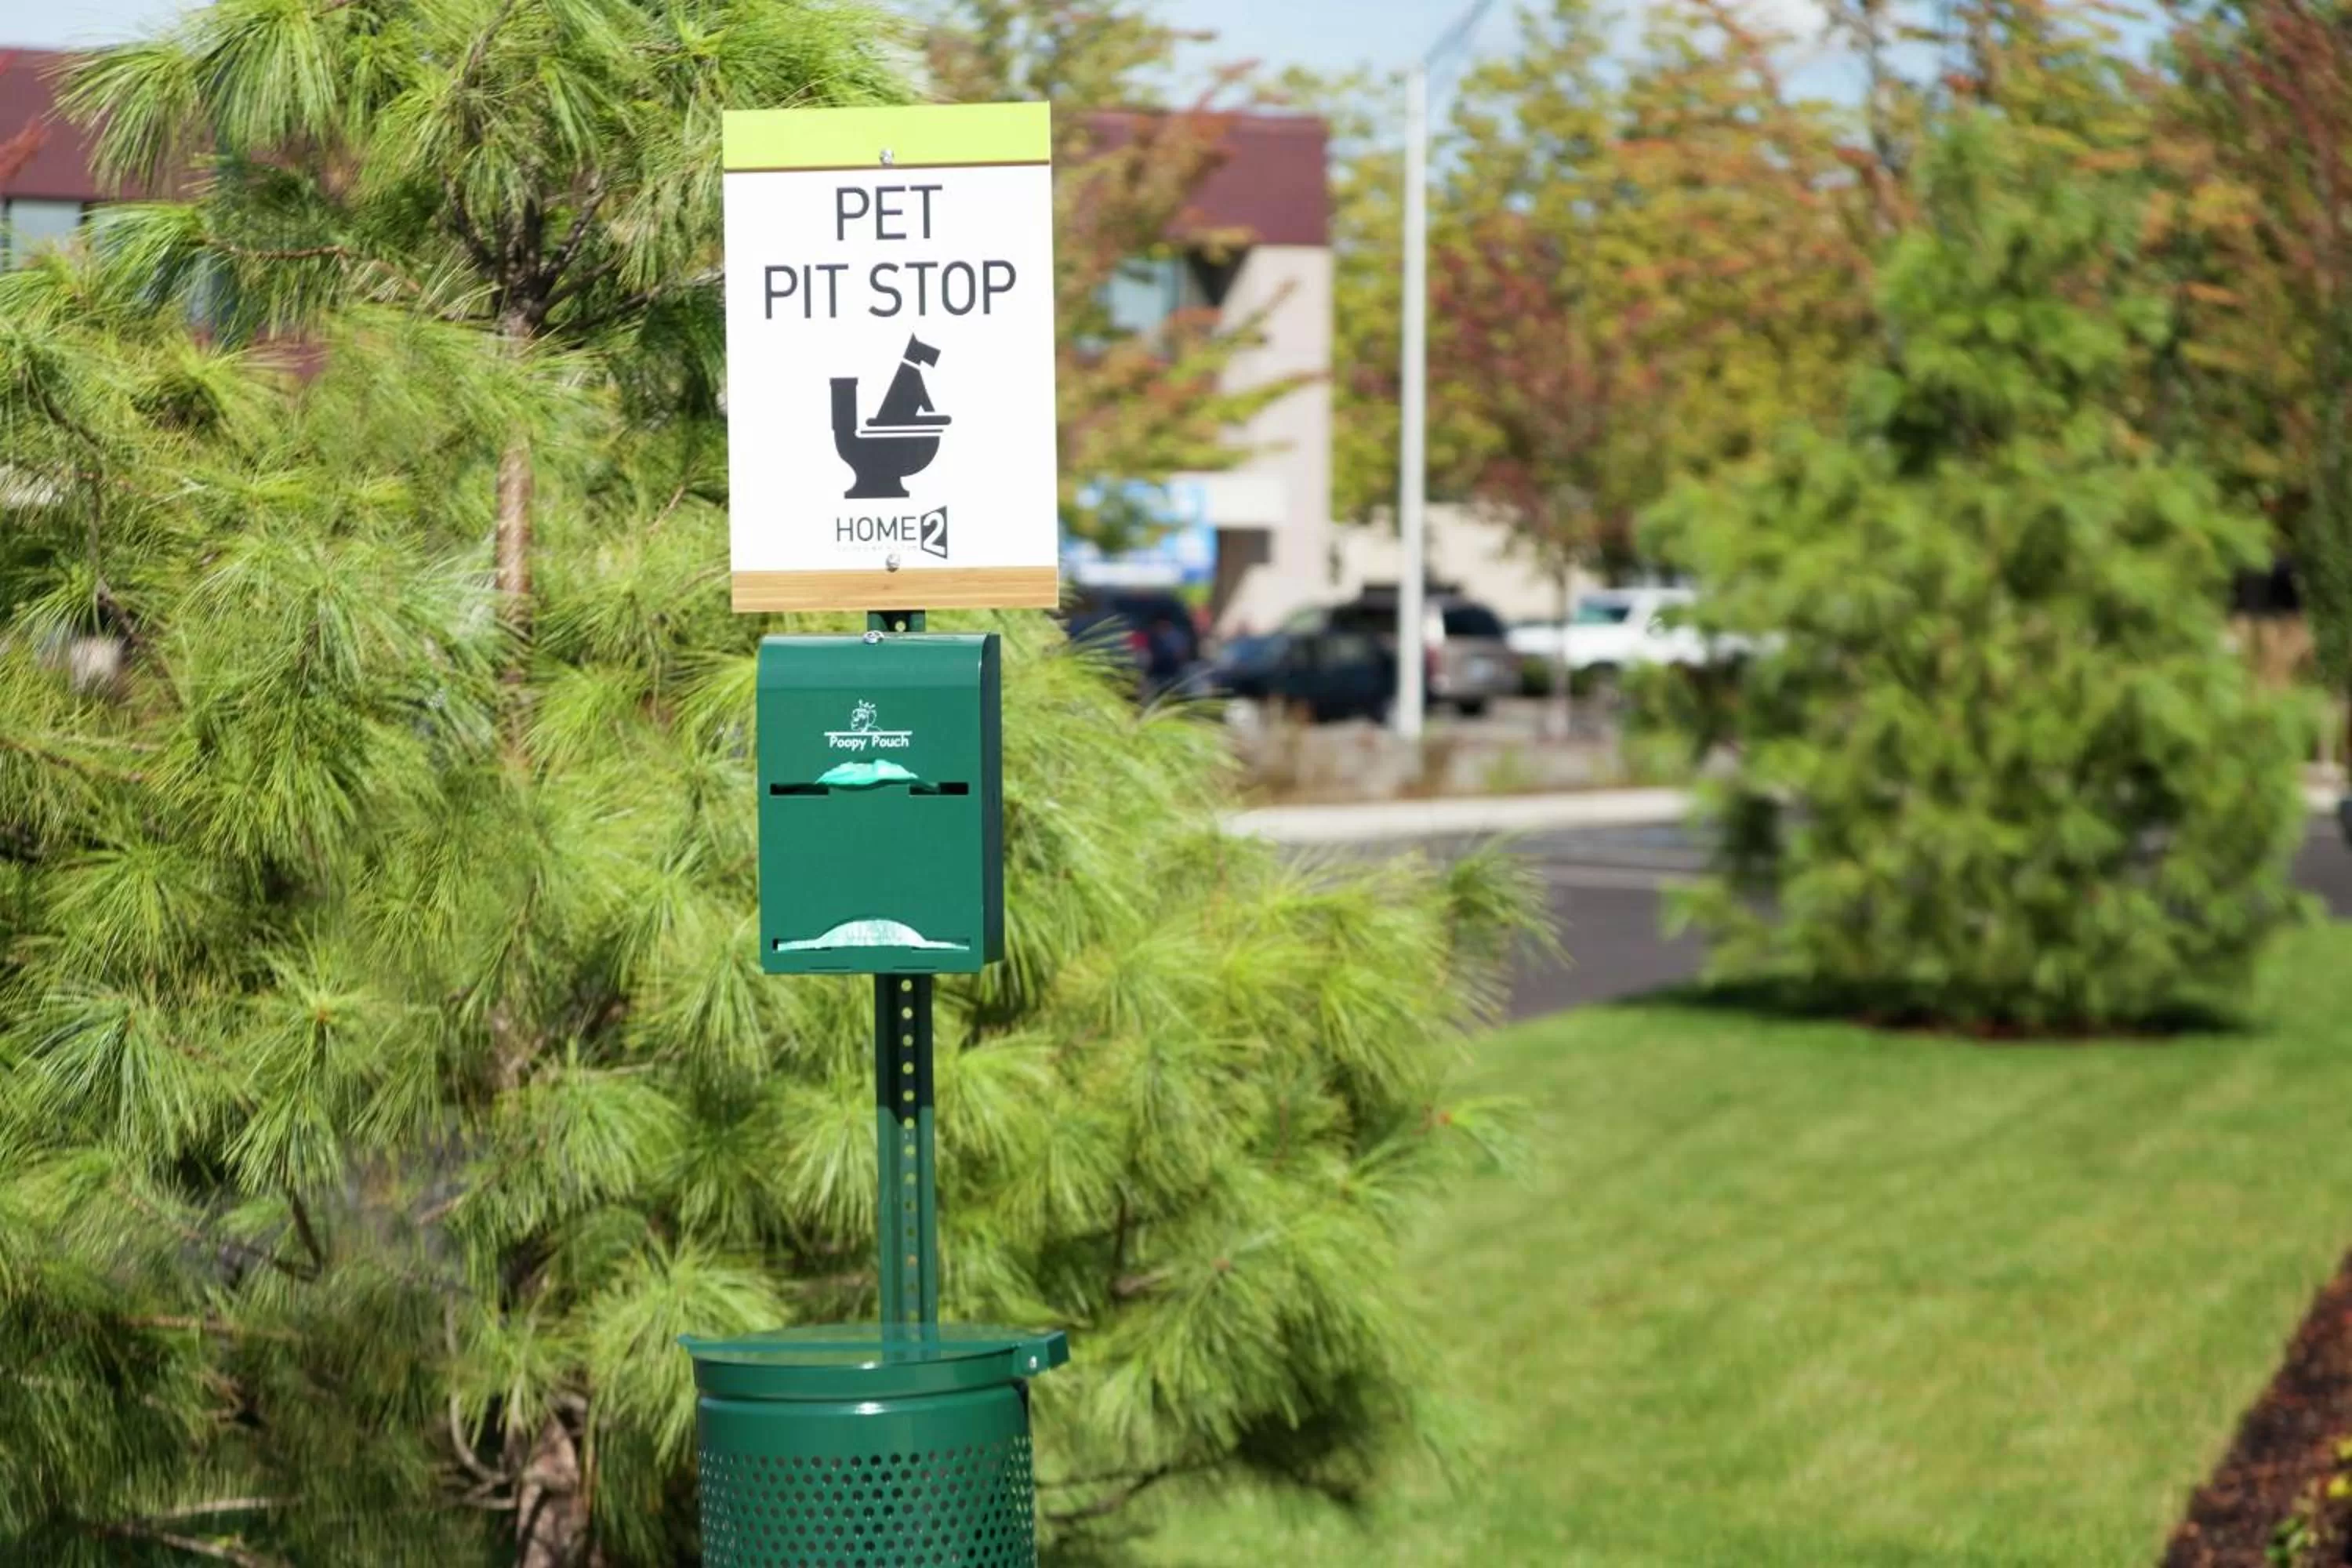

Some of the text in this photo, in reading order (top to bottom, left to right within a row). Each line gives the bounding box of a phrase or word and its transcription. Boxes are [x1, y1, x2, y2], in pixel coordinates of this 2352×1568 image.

[836, 184, 943, 241] PET
[764, 260, 1017, 320] PIT STOP
[829, 734, 909, 751] Poopy Pouch
